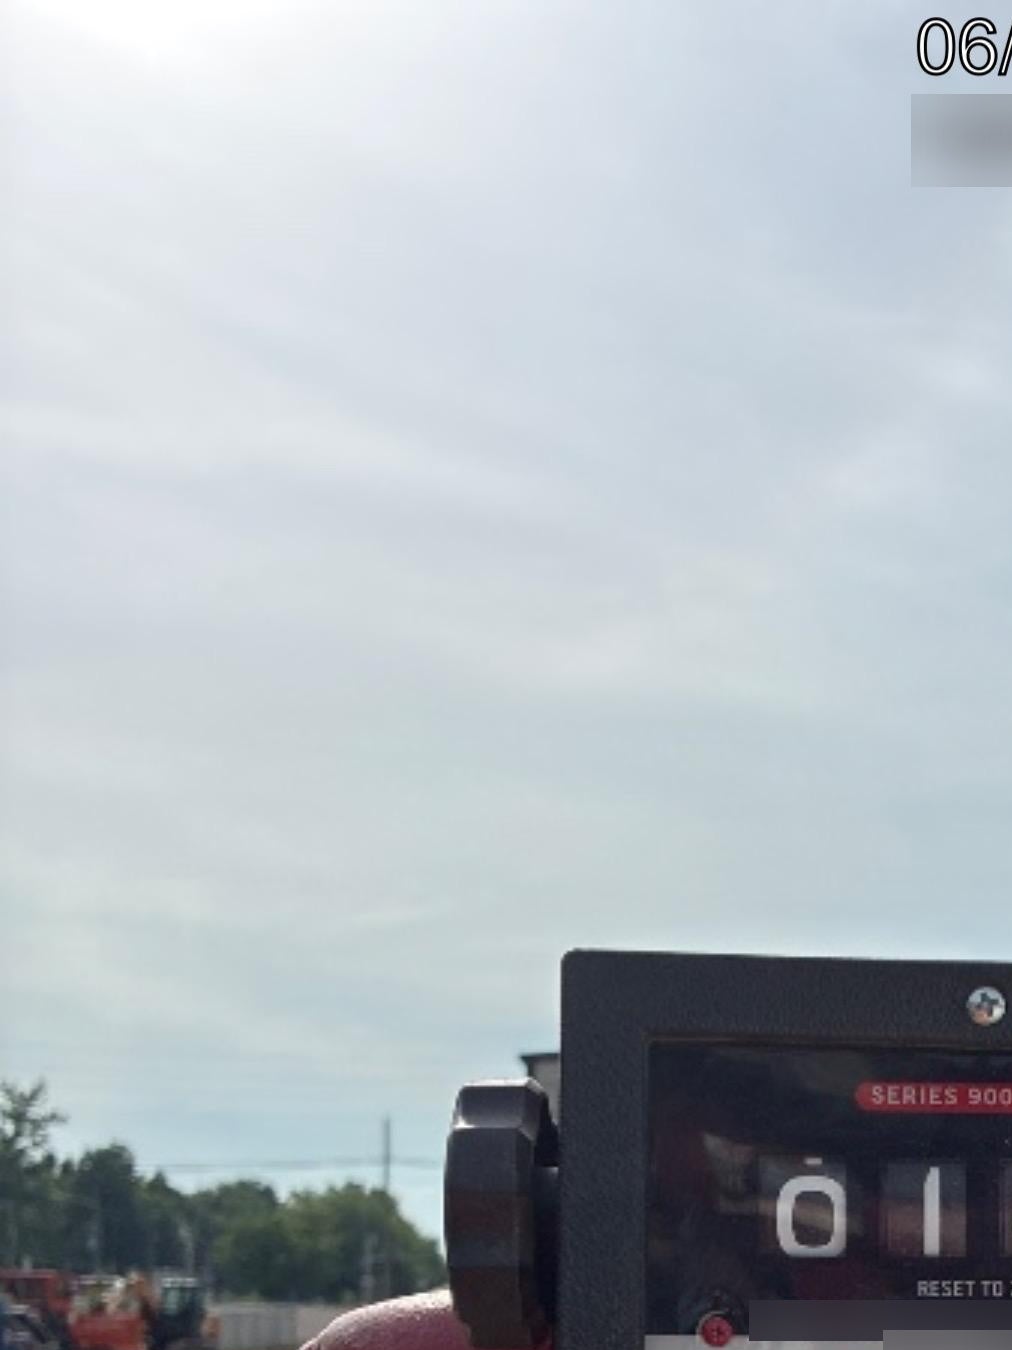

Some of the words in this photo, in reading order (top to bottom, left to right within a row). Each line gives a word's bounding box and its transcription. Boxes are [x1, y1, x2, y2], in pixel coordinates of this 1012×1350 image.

[871, 1085, 958, 1106] SERIES
[967, 1087, 1012, 1106] 900
[917, 1280, 975, 1298] RESET
[981, 1280, 1003, 1298] TO
